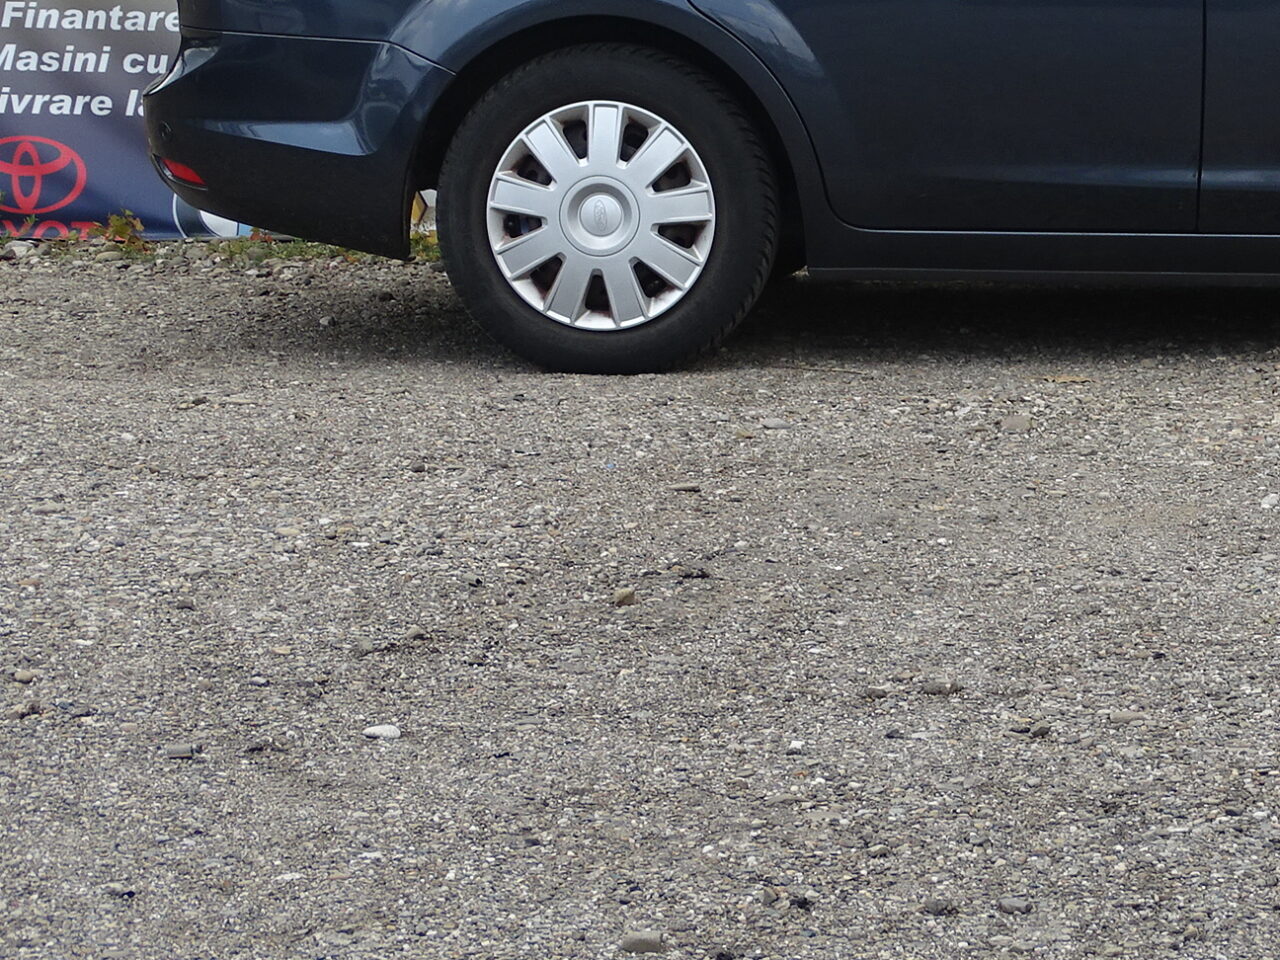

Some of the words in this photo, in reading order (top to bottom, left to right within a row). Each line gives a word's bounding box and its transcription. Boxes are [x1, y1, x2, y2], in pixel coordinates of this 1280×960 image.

[1, 0, 179, 32] Finantare
[122, 52, 169, 74] cu
[125, 89, 145, 117] l
